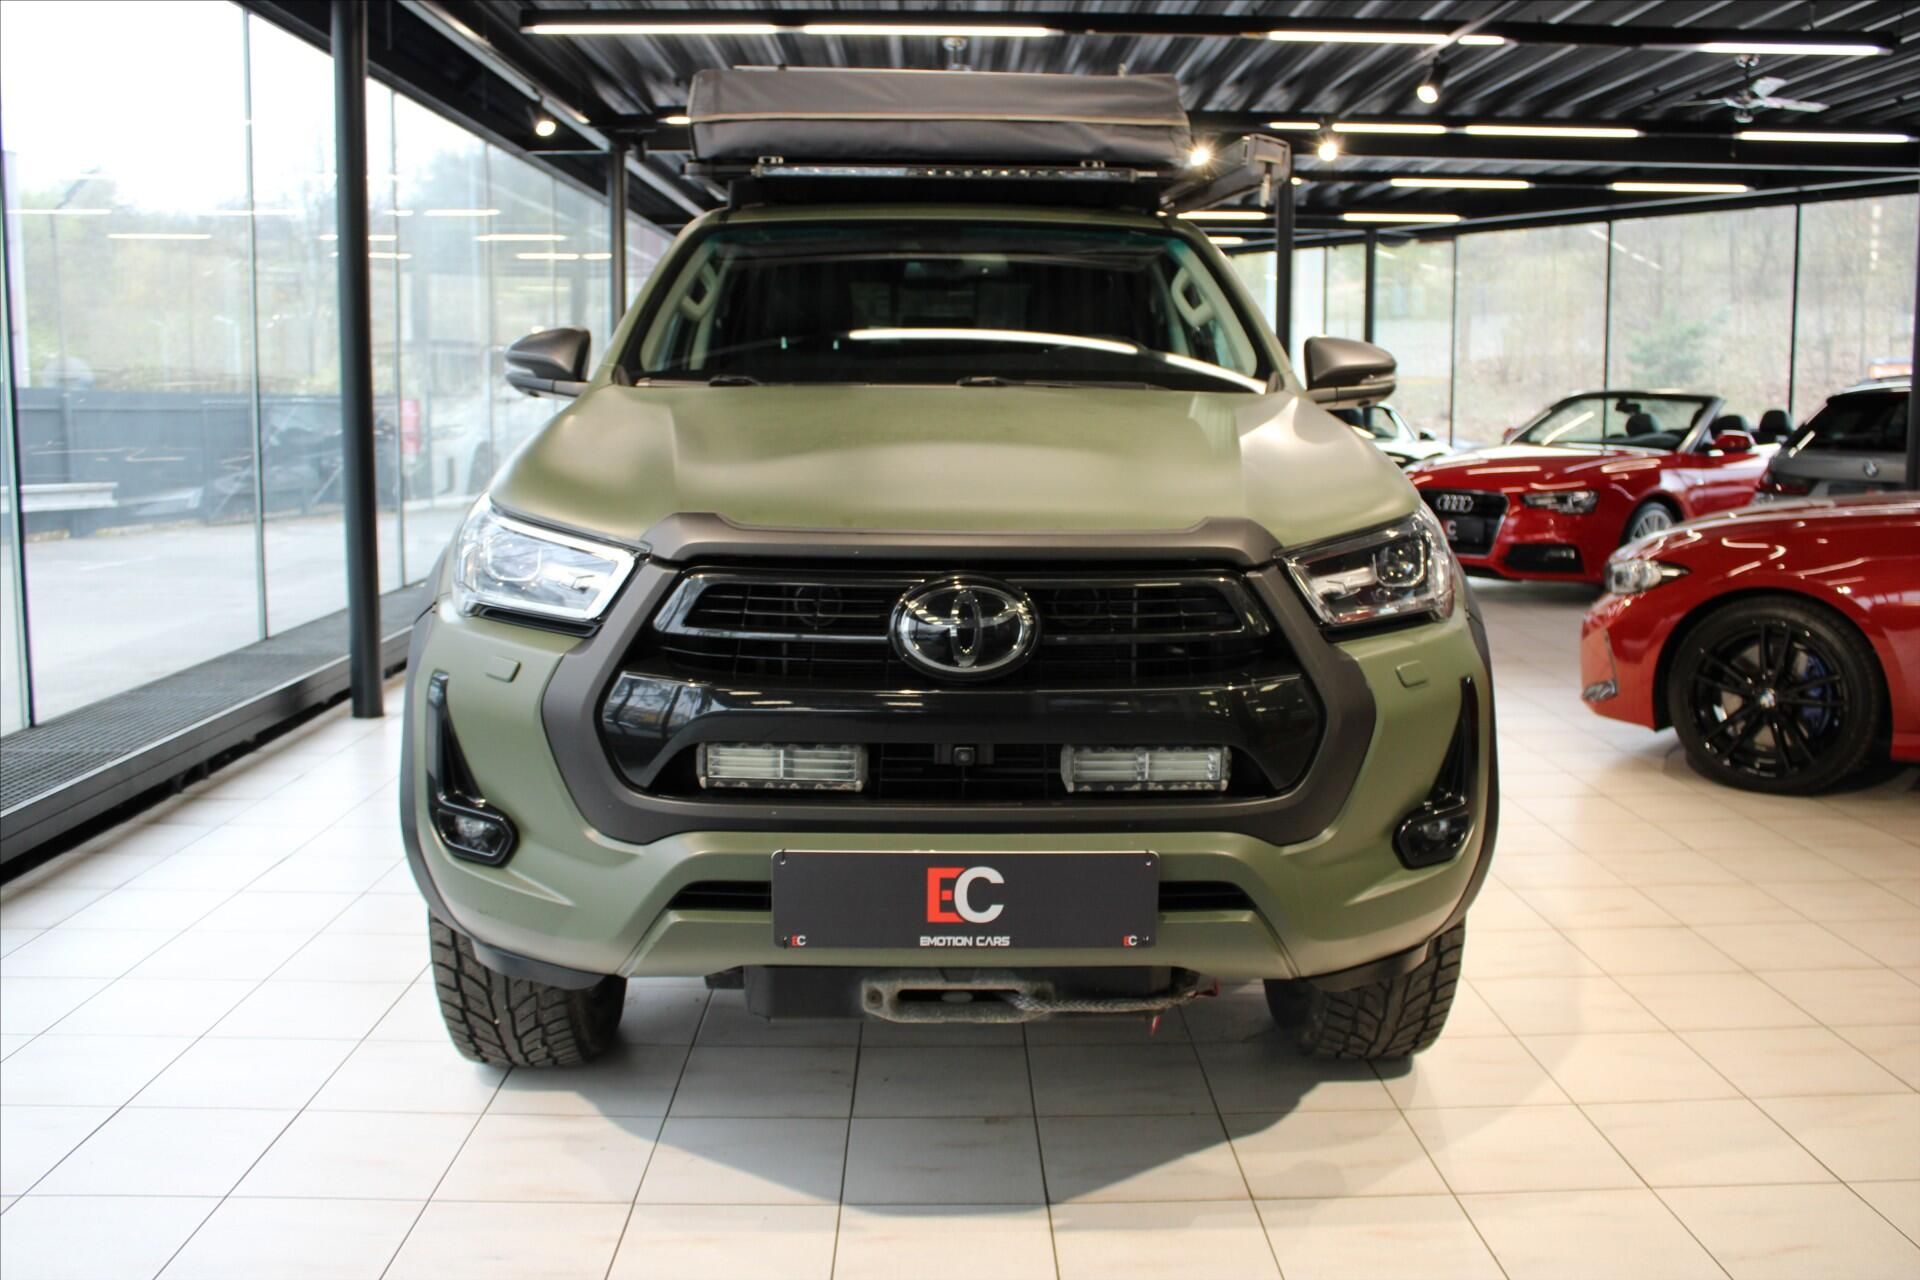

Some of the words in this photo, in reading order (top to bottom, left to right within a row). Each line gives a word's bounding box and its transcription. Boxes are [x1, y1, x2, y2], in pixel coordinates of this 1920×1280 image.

[926, 865, 1005, 923] EC
[791, 935, 807, 947] EC
[919, 936, 973, 947] EMOTION
[975, 936, 1011, 947] CARS
[1123, 935, 1137, 947] EC
